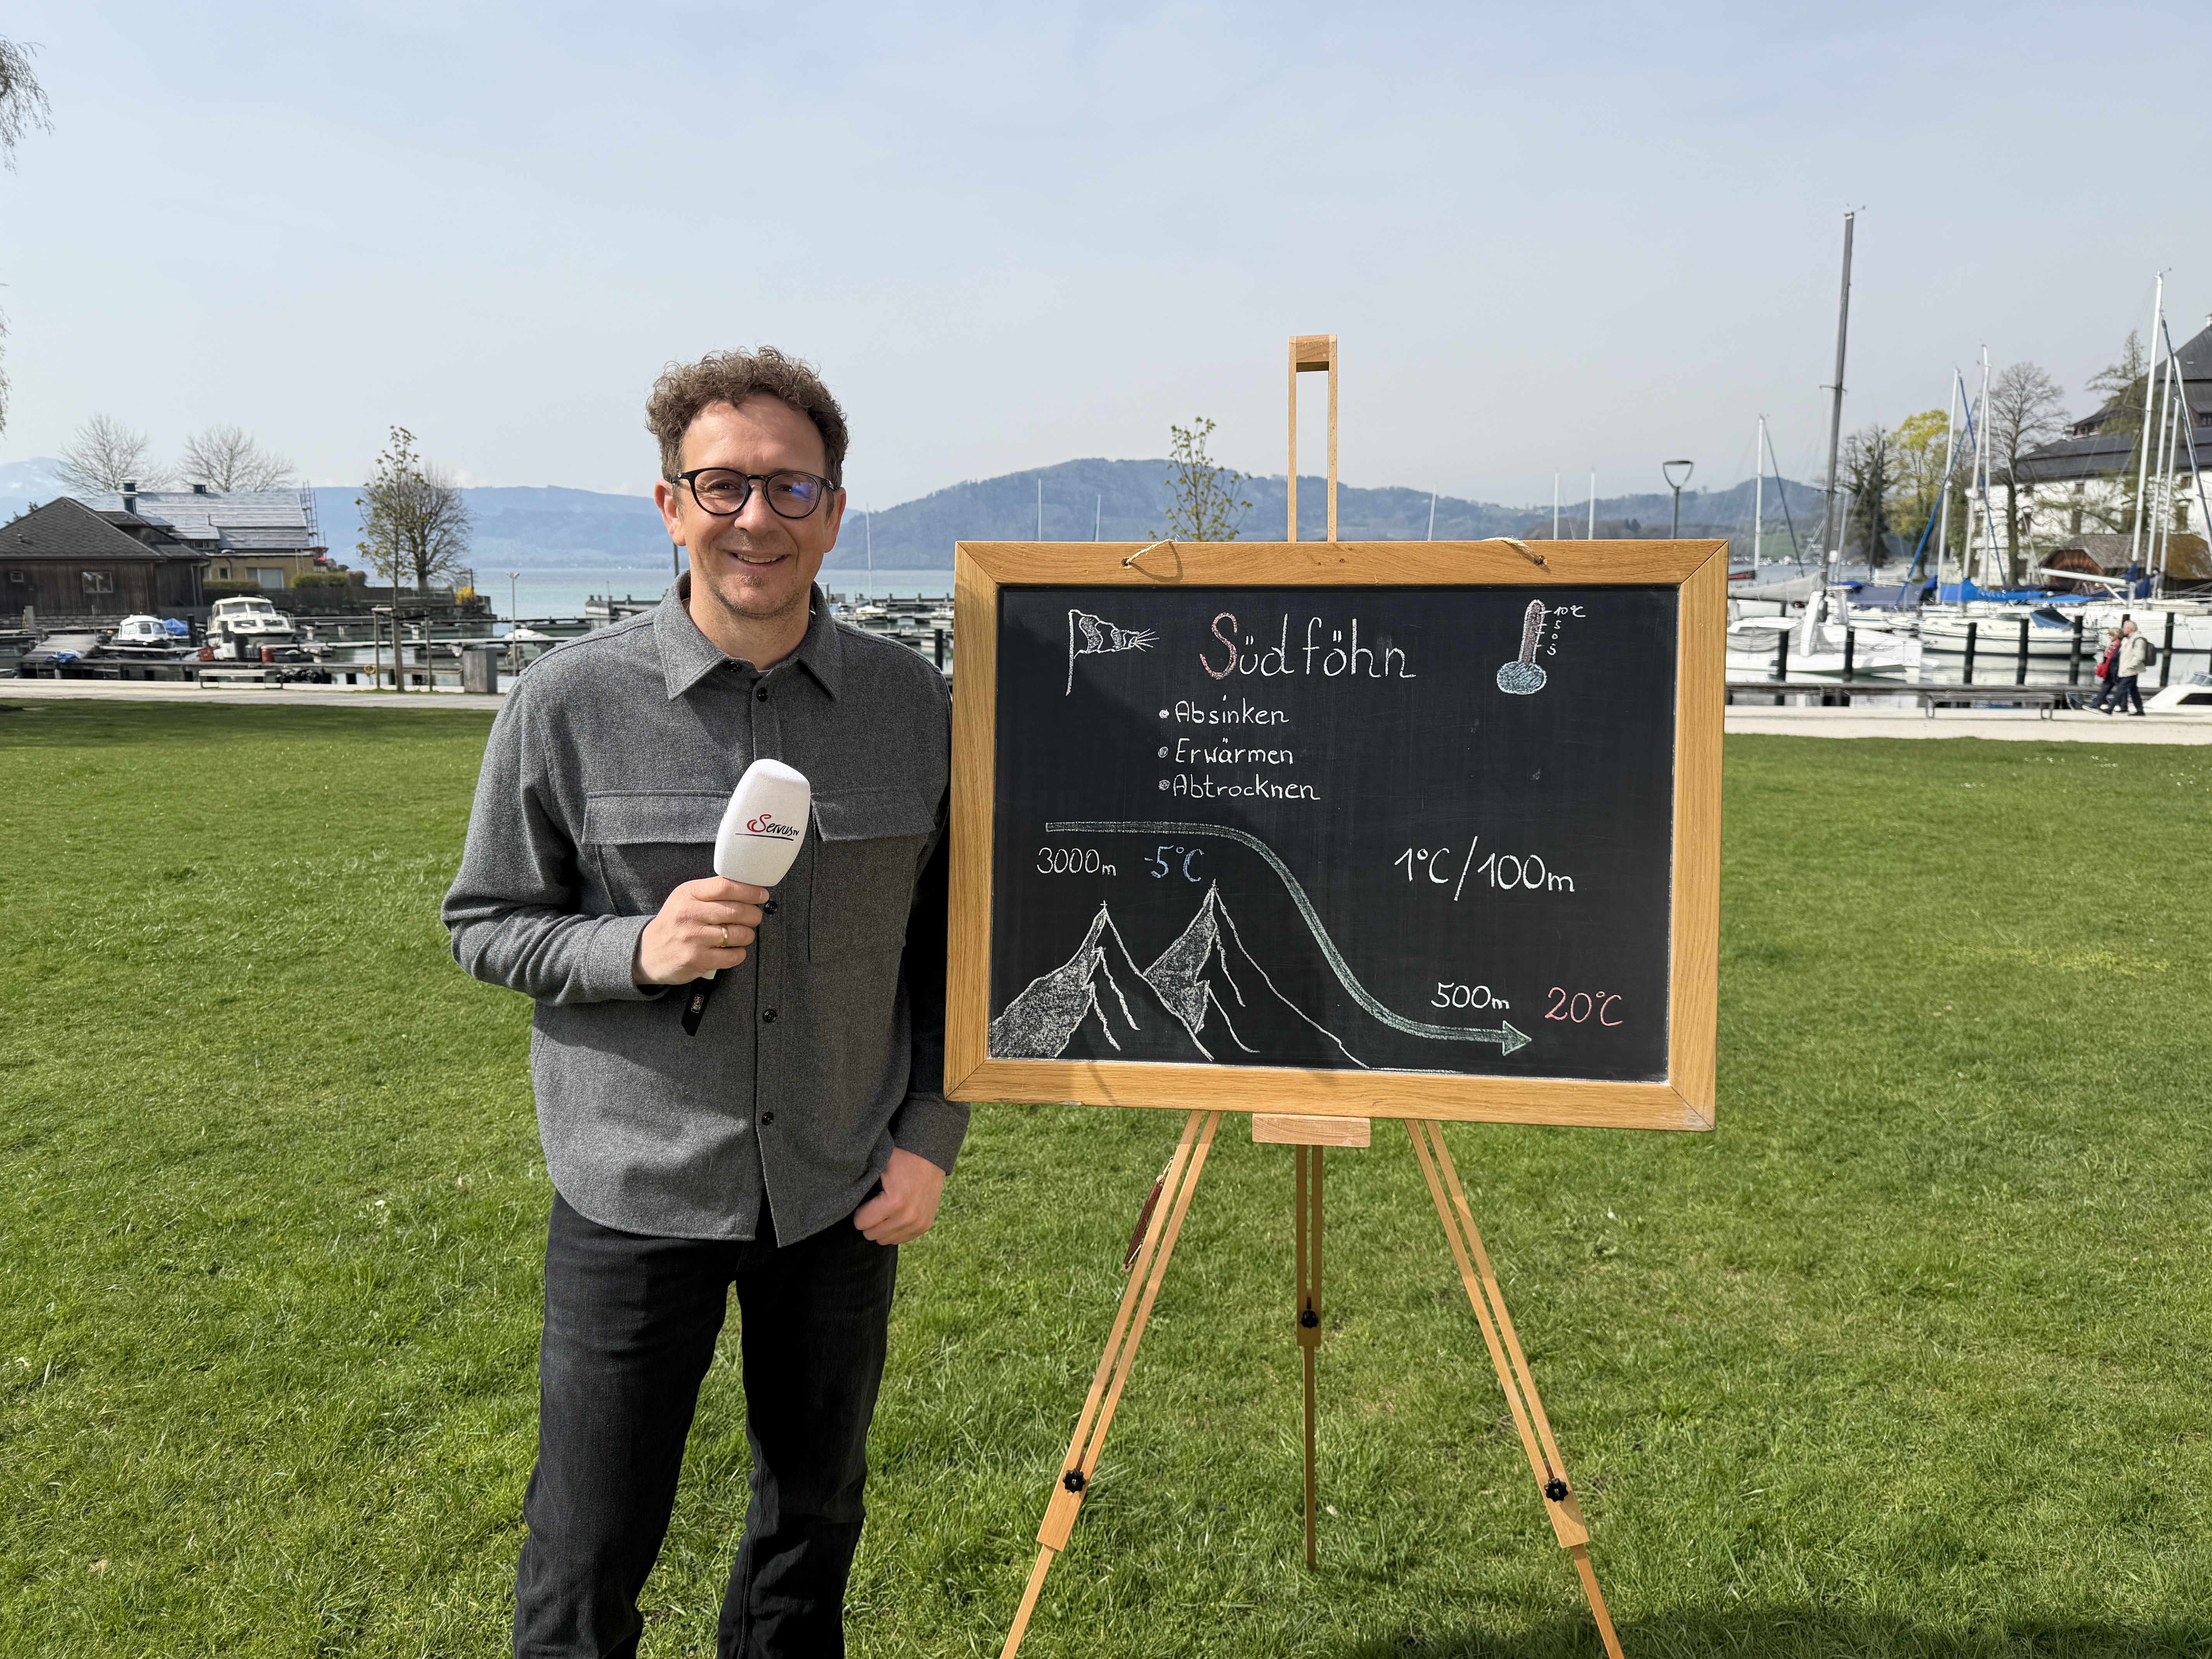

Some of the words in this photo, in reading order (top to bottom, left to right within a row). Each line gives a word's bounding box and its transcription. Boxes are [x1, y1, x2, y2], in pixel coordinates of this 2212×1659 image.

[1553, 605, 1586, 618] 10°C
[1554, 620, 1561, 629] 5
[1199, 612, 1417, 680] Südföhn
[1175, 694, 1290, 725] Absinken
[1175, 737, 1294, 765] Erwärmen
[1173, 773, 1321, 800] Abtrocknen
[1037, 847, 1117, 877] 3000m
[1144, 845, 1205, 883] -5°C
[1394, 836, 1575, 902] 1°C/100m
[1431, 982, 1510, 1010] 500m
[1544, 987, 1624, 1027] 20°C
